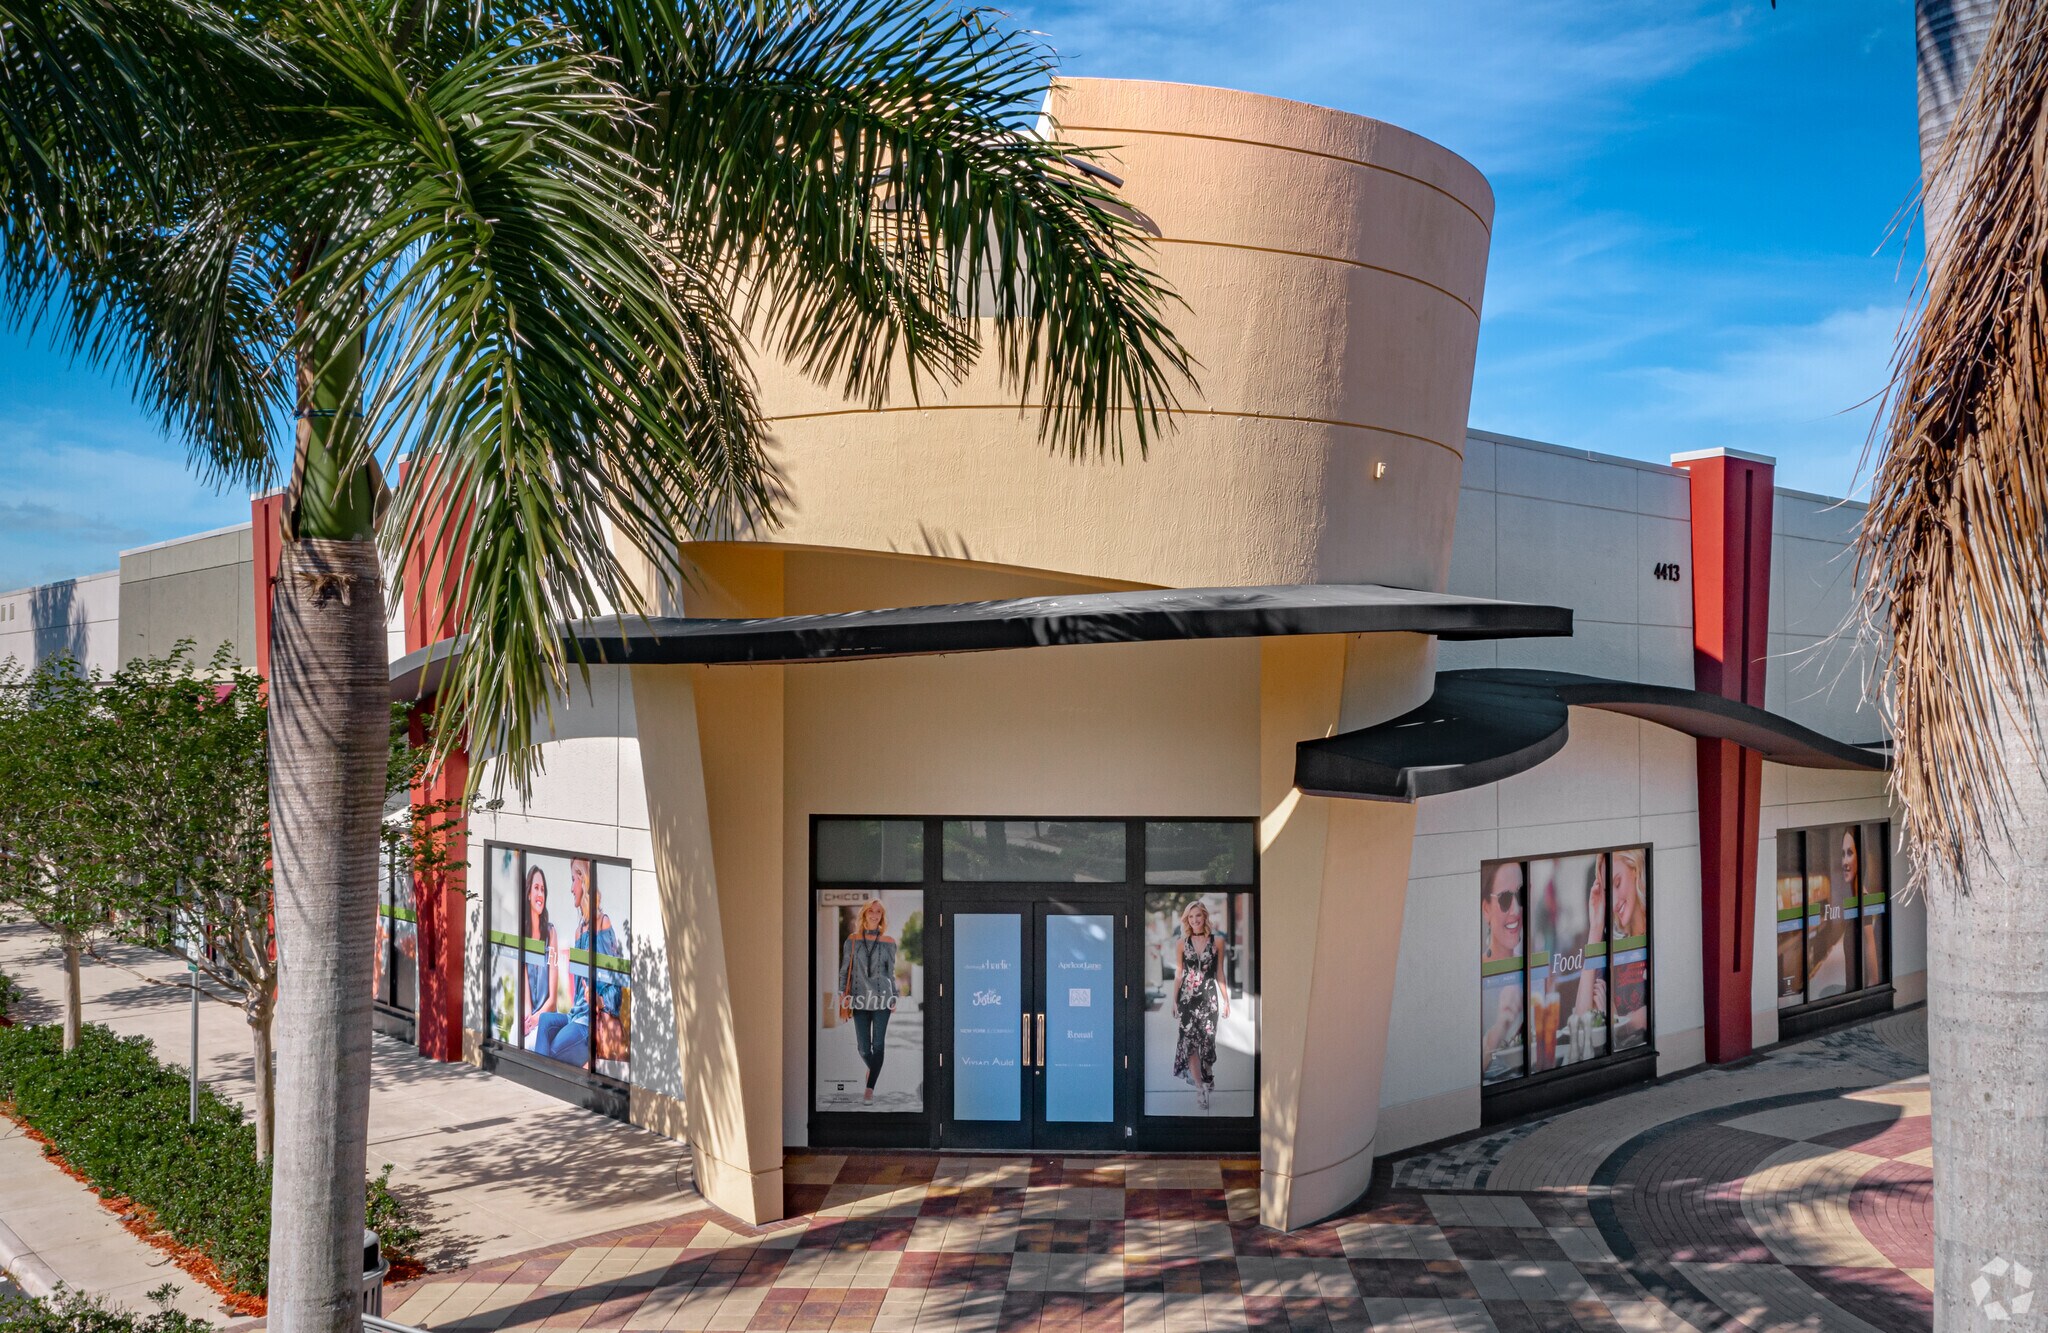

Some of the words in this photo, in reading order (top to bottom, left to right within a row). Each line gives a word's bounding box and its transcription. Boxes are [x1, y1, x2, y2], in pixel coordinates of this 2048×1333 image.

[1654, 562, 1680, 581] 4413
[824, 893, 869, 901] CHICOS
[1823, 903, 1841, 921] Fun
[1552, 949, 1583, 973] Food
[828, 990, 900, 1011] Fashio
